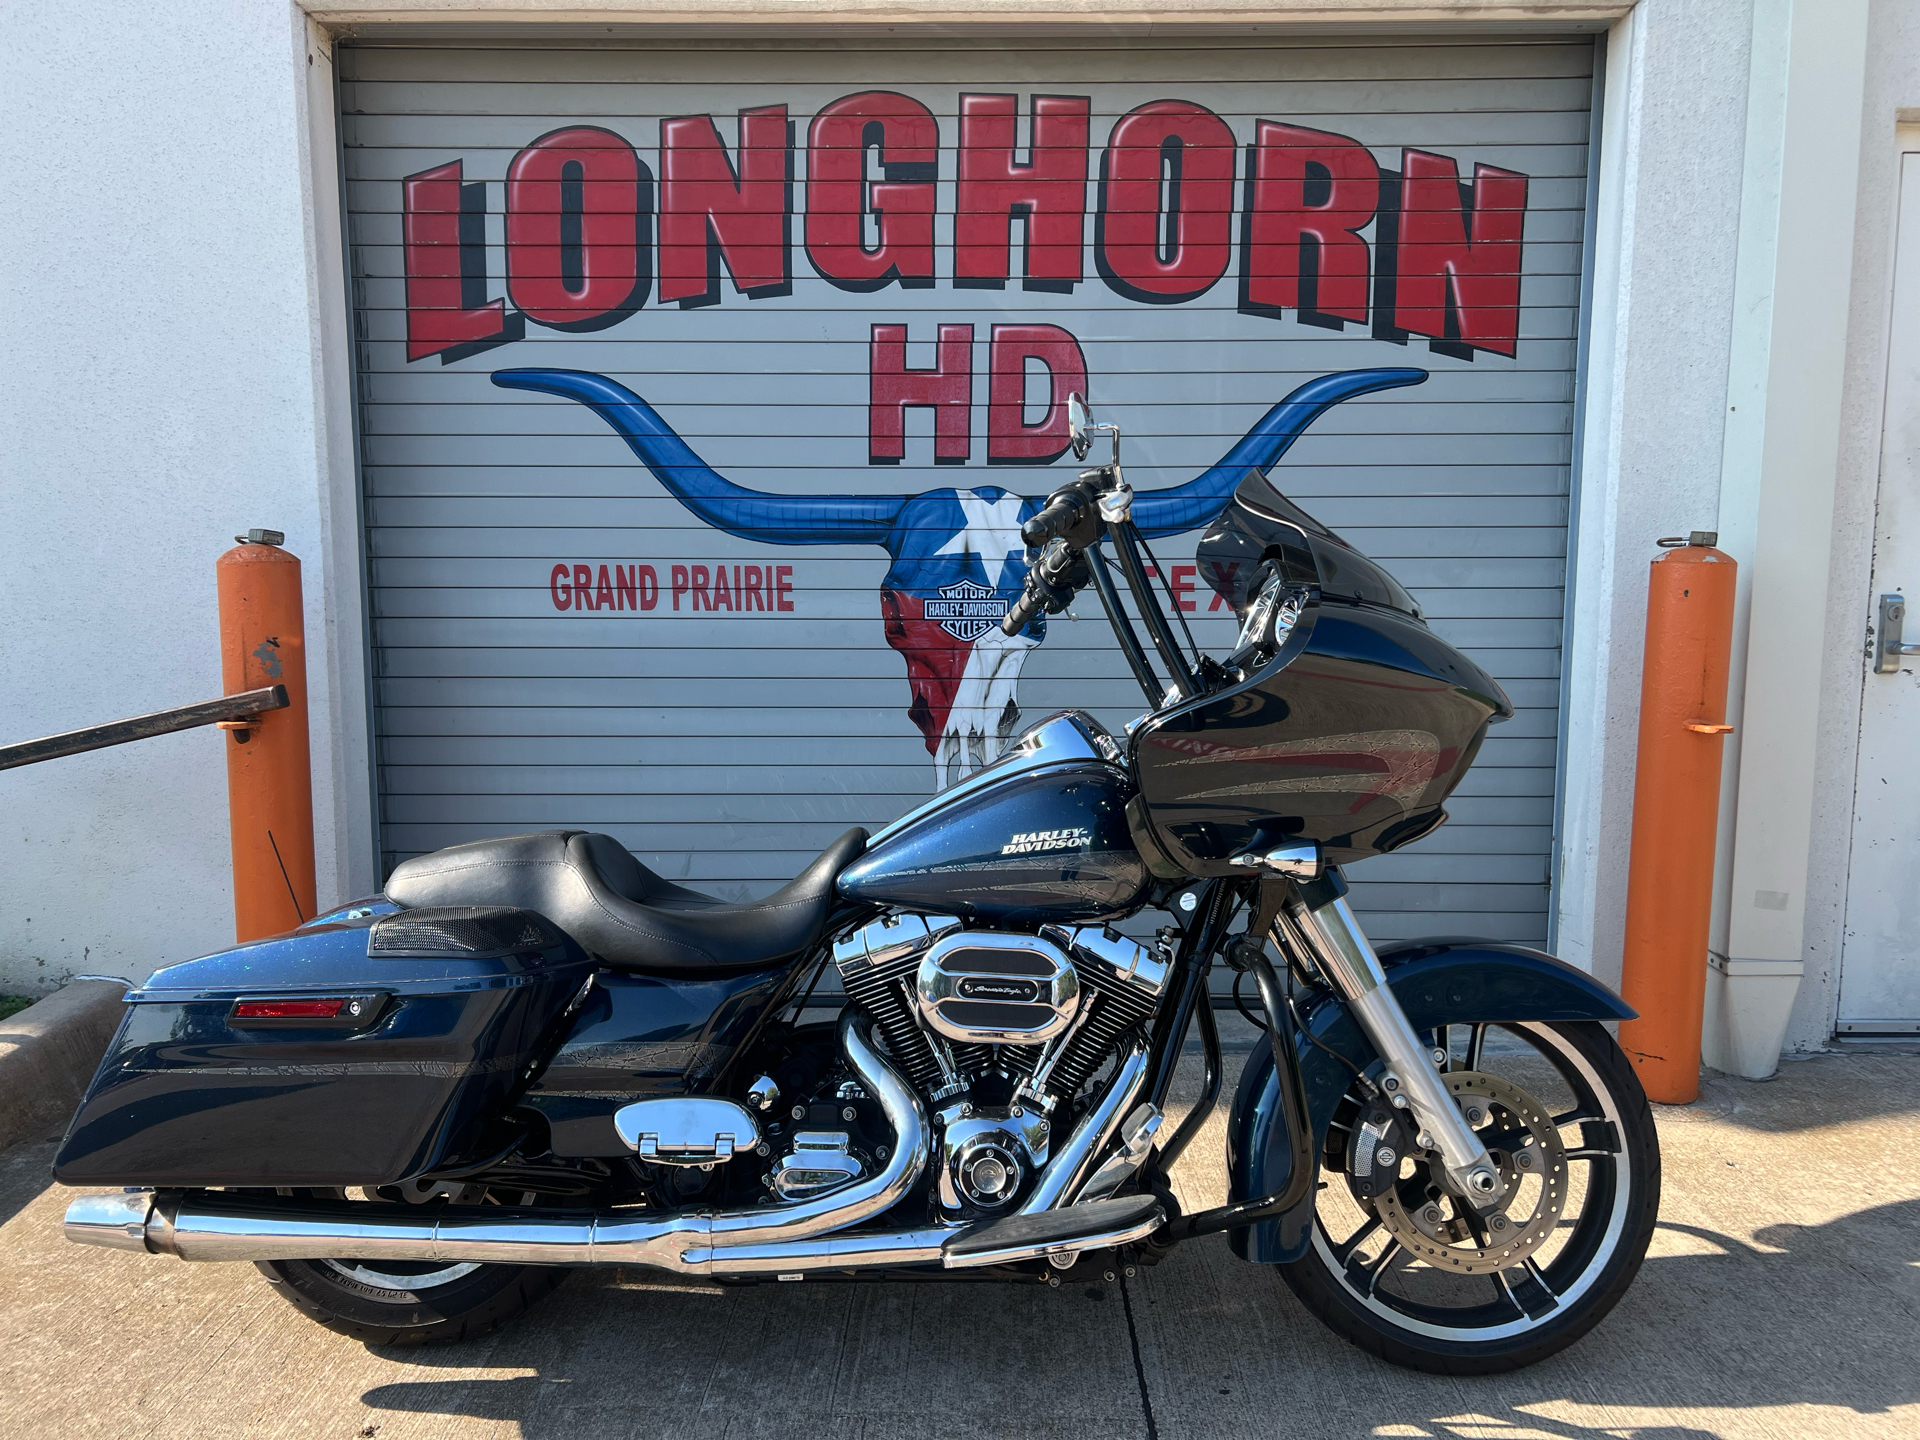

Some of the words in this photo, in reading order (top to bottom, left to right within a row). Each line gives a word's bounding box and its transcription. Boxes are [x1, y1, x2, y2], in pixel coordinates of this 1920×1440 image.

[402, 90, 1530, 366] LONGHORN
[869, 323, 1089, 465] HD
[551, 564, 659, 611] GRAND
[671, 565, 795, 612] PRAIRIE
[946, 588, 988, 599] MOTOR
[928, 602, 1005, 617] HARLEY-DAVIDSON
[945, 620, 988, 638] CYCLES
[1010, 827, 1089, 844] HARLEY-
[1000, 836, 1093, 855] DAVIDSON
